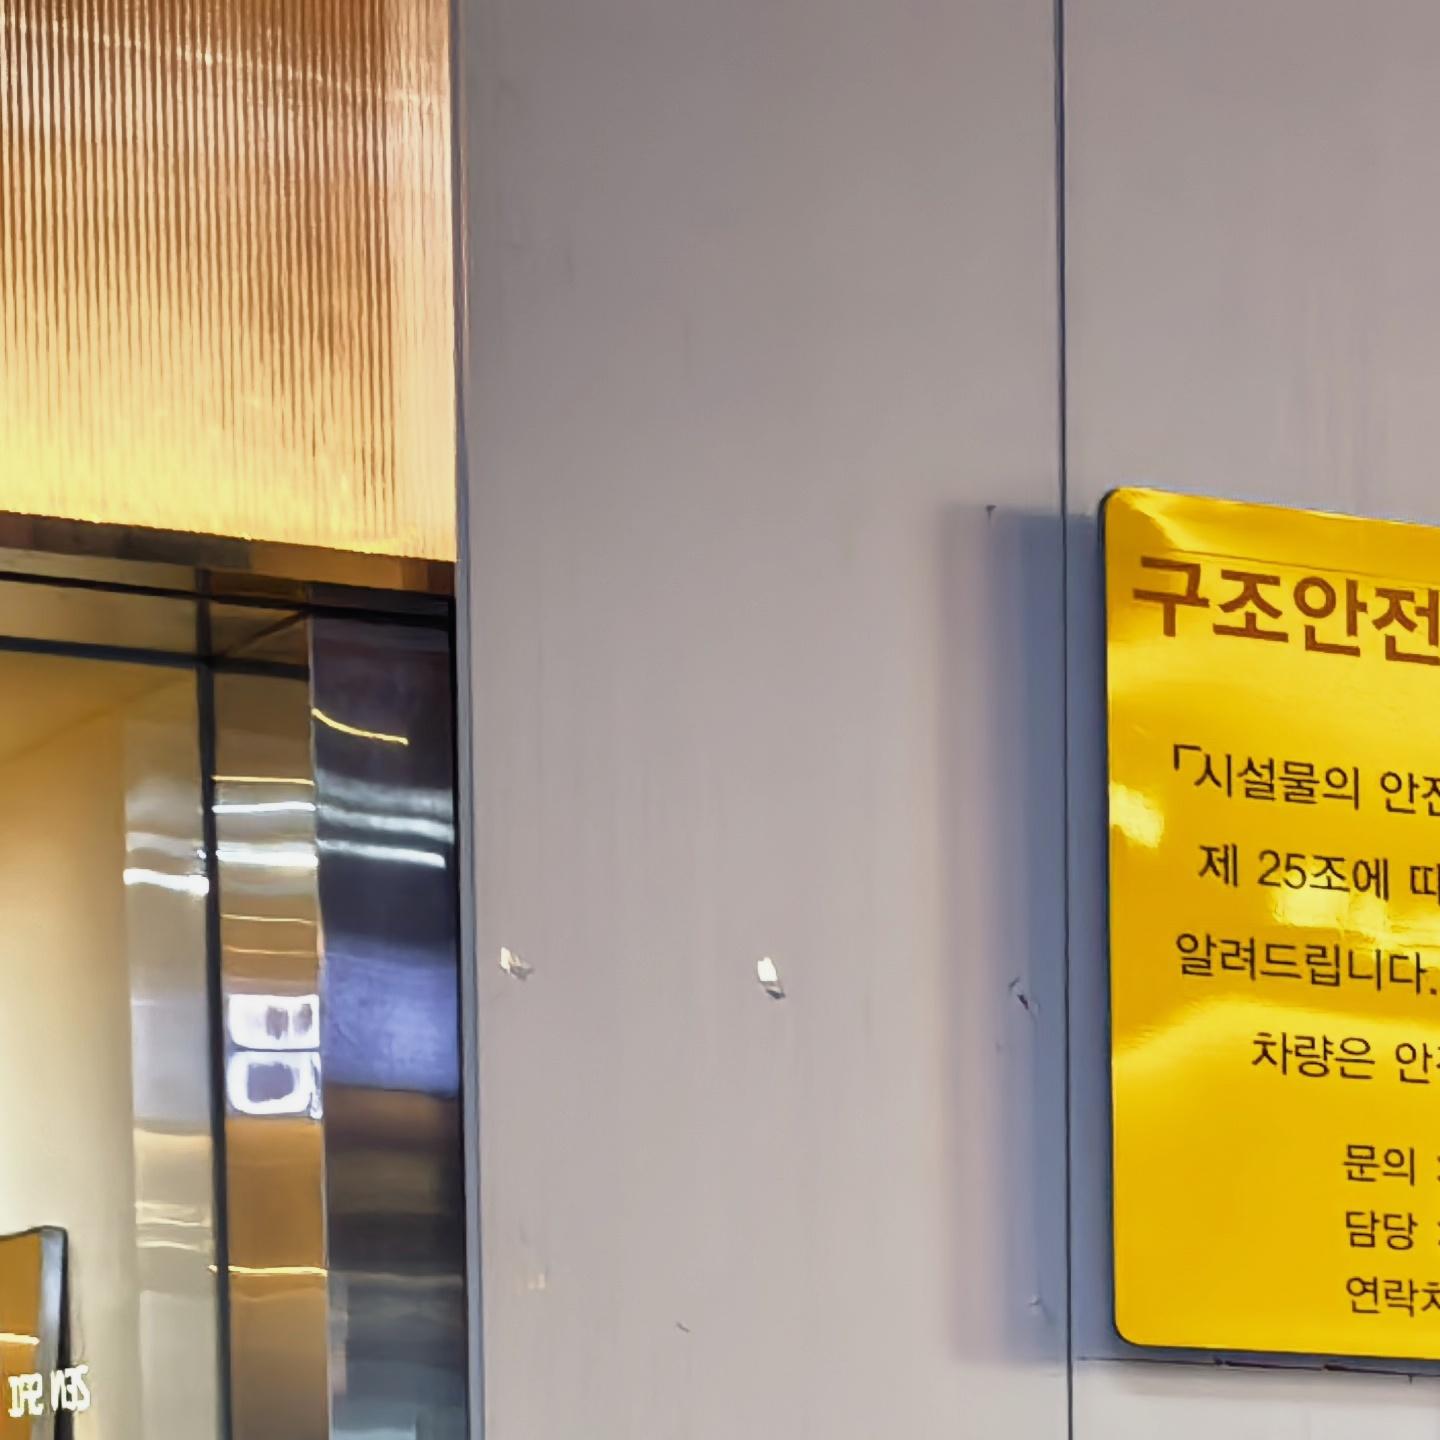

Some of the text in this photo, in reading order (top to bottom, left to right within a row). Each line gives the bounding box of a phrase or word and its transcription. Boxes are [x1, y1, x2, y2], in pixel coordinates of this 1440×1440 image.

[1199, 842, 1239, 889] 제
[1258, 847, 1389, 905] 25조에
[1175, 931, 1438, 998] 알려드립니다.
[1251, 1030, 1375, 1081] 차량은
[1343, 1143, 1417, 1184] 문의
[1346, 1212, 1418, 1254] 담당
